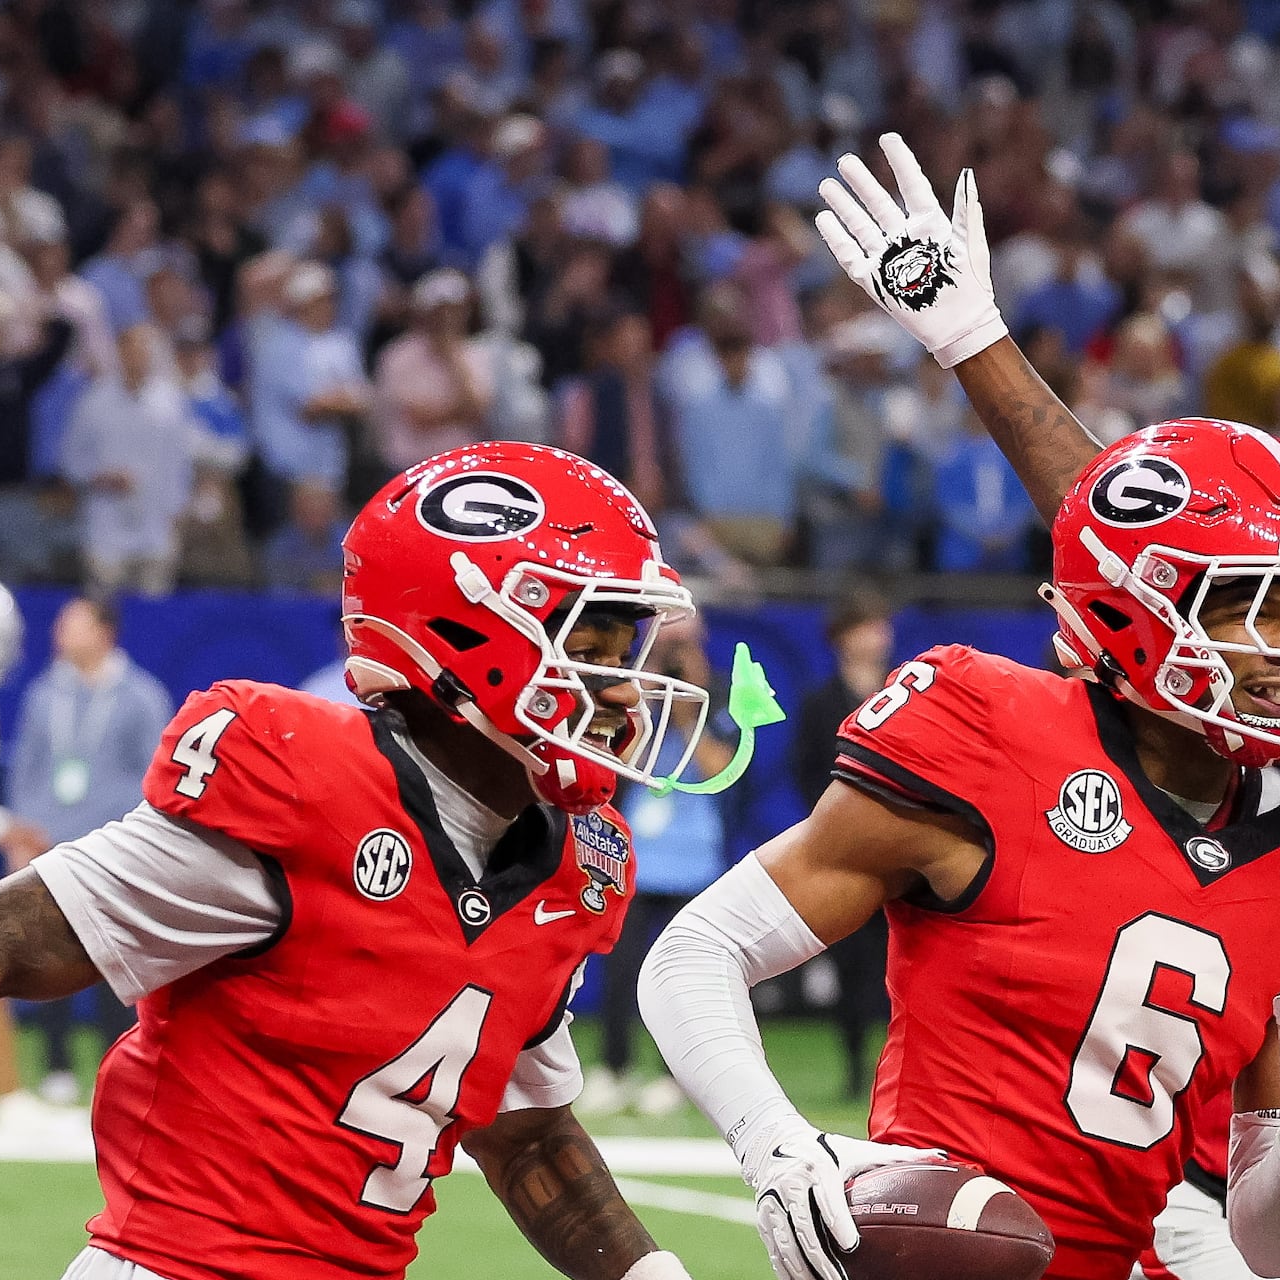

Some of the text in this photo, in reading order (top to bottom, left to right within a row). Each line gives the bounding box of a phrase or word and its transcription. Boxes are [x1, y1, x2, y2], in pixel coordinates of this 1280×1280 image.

[854, 660, 938, 731] 6
[170, 707, 237, 800] 4
[1054, 820, 1122, 852] GRADUATE
[1065, 774, 1118, 831] SEC
[357, 834, 408, 895] SEC
[1065, 911, 1233, 1151] 6
[337, 984, 493, 1216] 4
